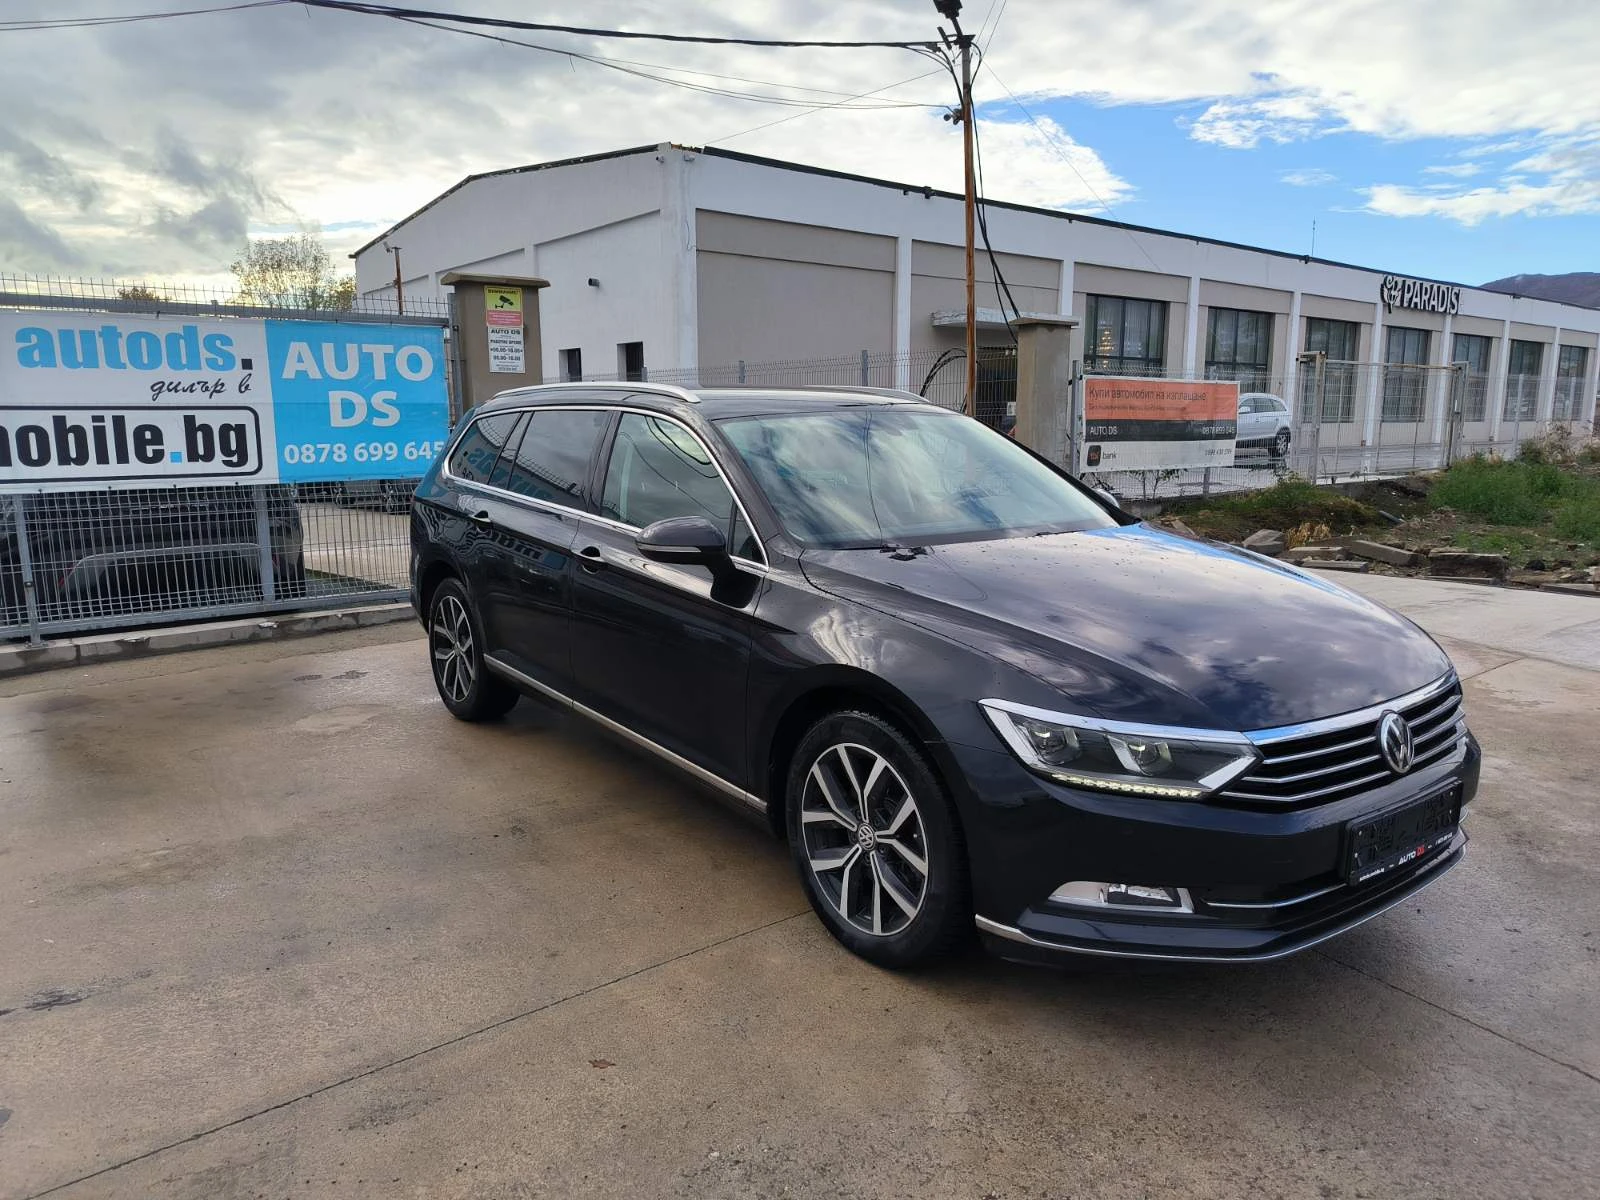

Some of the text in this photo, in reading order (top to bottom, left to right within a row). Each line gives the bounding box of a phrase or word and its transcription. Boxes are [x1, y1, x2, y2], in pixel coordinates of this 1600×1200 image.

[1403, 280, 1459, 314] PARADIS
[15, 325, 253, 372] autods.
[282, 341, 434, 380] AUTO
[151, 374, 252, 401] дилър в
[1090, 388, 1110, 401] Купи
[1112, 389, 1154, 400] автомобил
[1156, 391, 1165, 400] на
[328, 390, 401, 428] DS
[1090, 426, 1108, 435] AUTO
[284, 441, 444, 465] 0878 699 645
[1103, 451, 1116, 460] bank
[1398, 851, 1416, 865] AUTO
